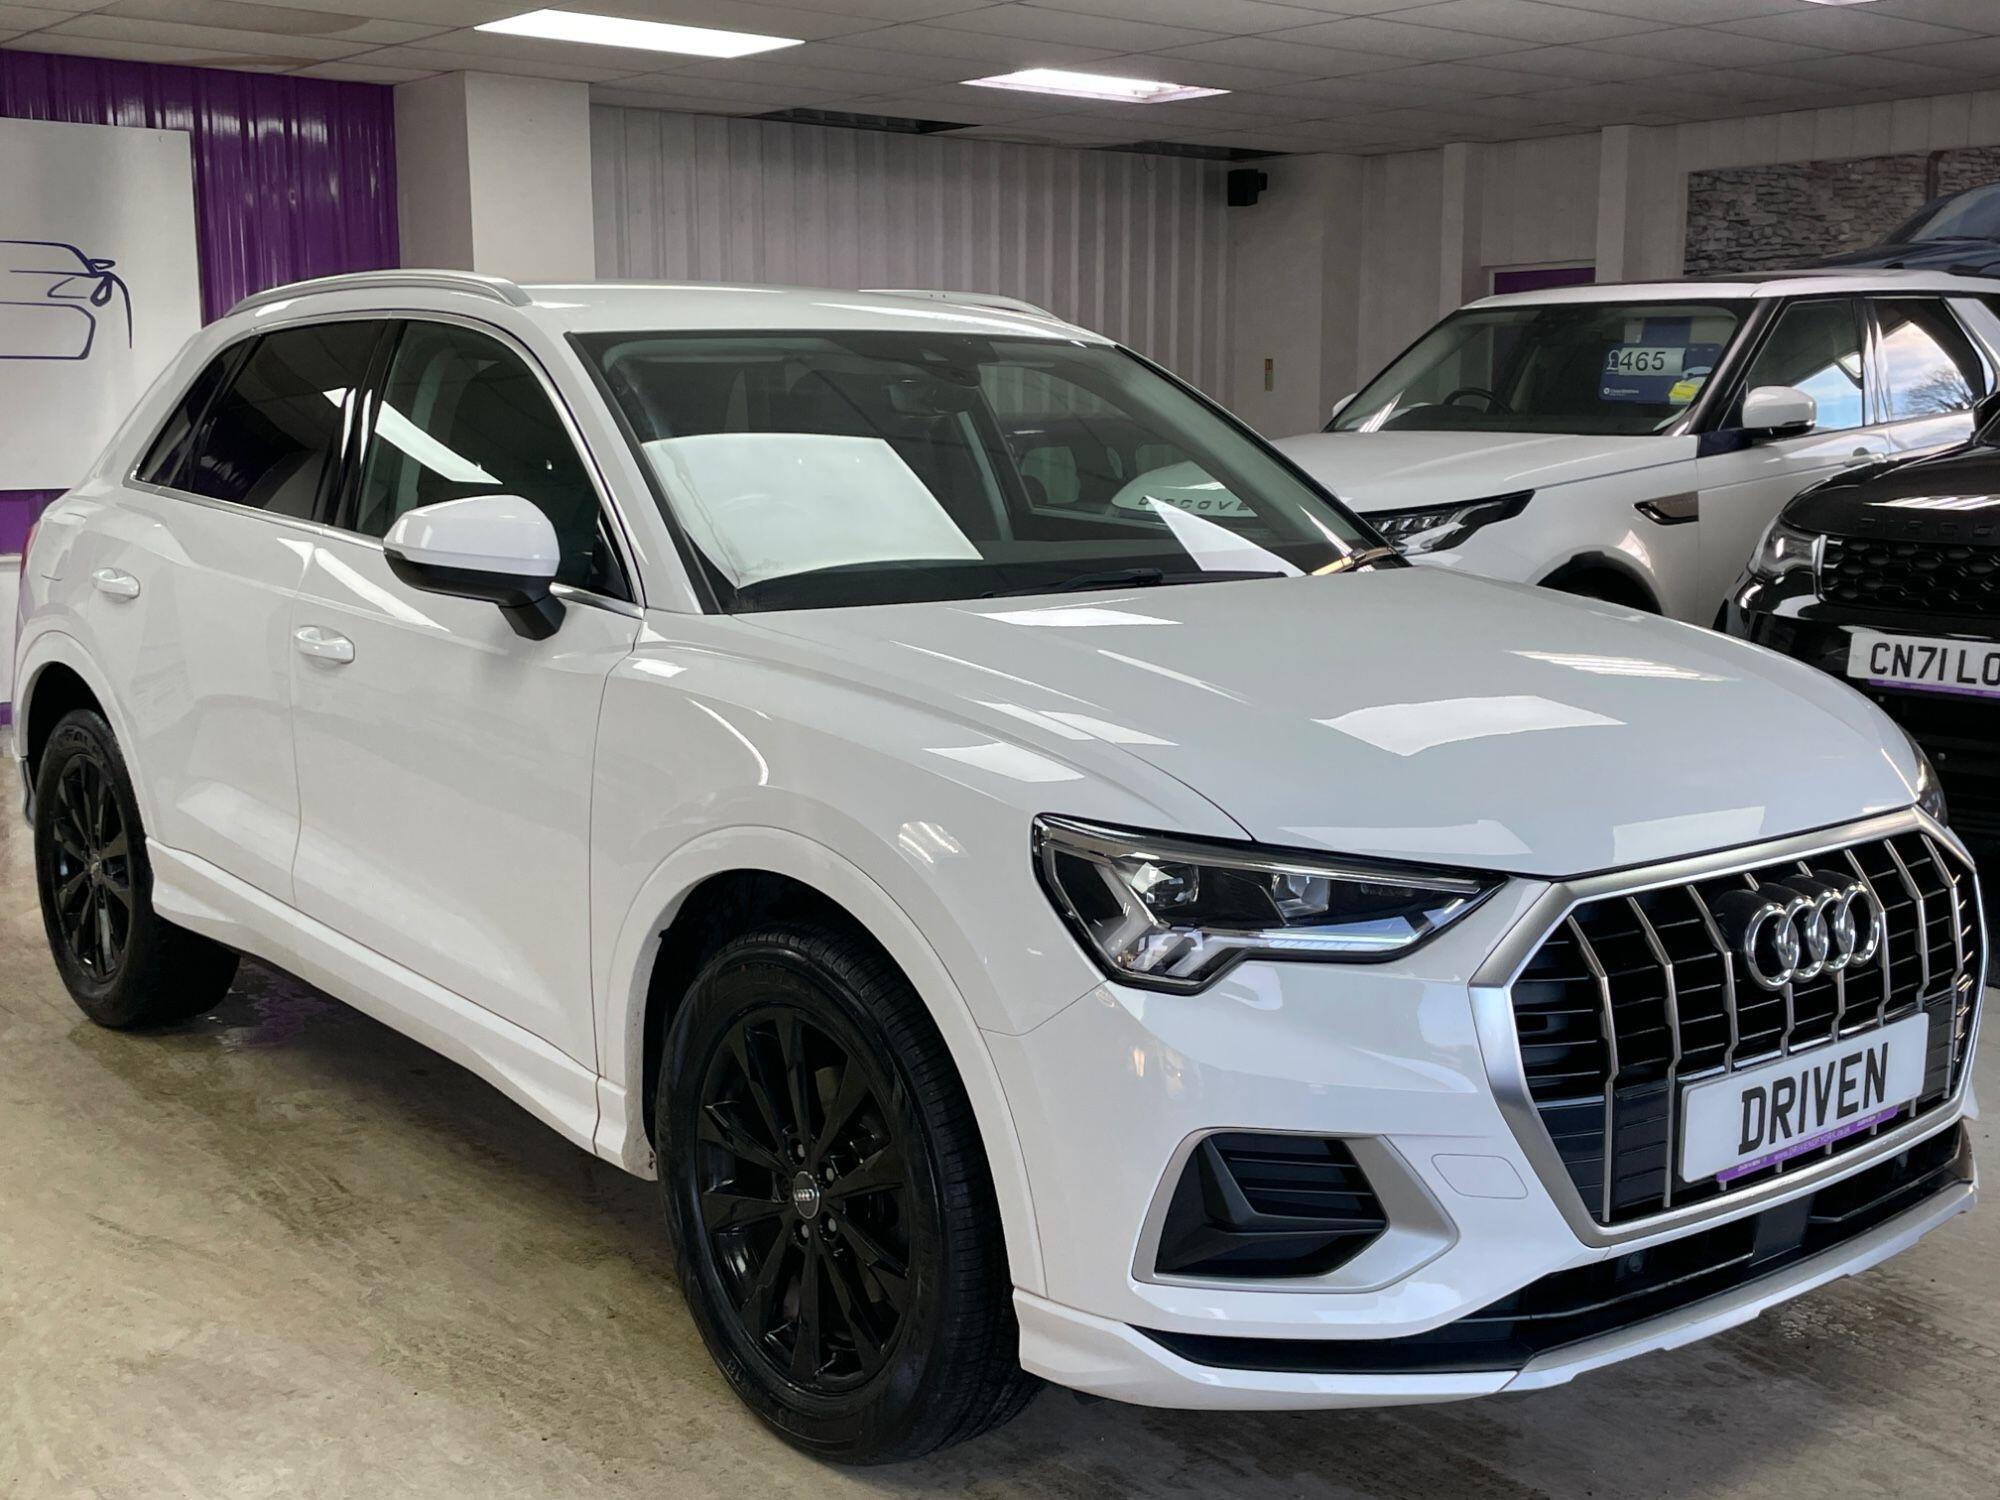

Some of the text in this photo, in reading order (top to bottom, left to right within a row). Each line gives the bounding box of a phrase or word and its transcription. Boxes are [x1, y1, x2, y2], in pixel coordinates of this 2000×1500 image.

[1138, 496, 1250, 511] DCOVE
[1869, 643, 1948, 681] CN71
[1738, 1042, 1889, 1155] DRIVEN
